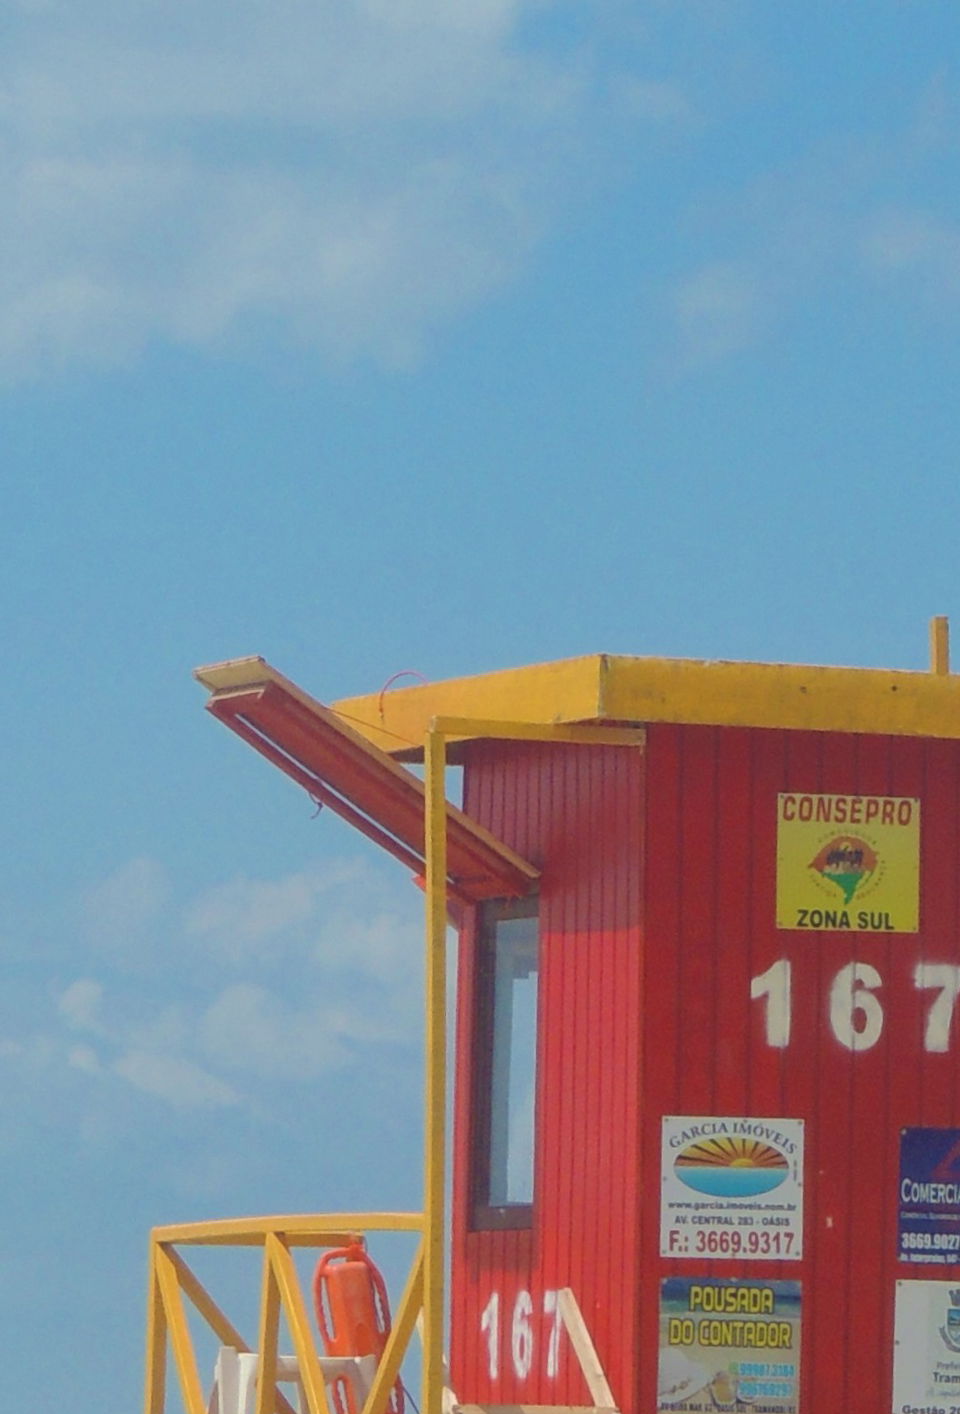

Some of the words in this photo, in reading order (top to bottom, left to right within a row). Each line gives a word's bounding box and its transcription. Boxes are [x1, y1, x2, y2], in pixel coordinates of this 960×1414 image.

[783, 796, 912, 826] CONSEPRO
[796, 909, 850, 928] ZONA
[858, 912, 895, 930] SUL
[669, 1122, 728, 1149] GARCIA
[733, 1121, 797, 1155] IMÓVEIS
[691, 1216, 734, 1225] CENTRAL
[669, 1230, 689, 1252] F.:
[696, 1231, 795, 1254] 3669.9317
[689, 1285, 775, 1314] POUSADA
[669, 1318, 695, 1345] DO
[698, 1318, 793, 1349] CONTADOR
